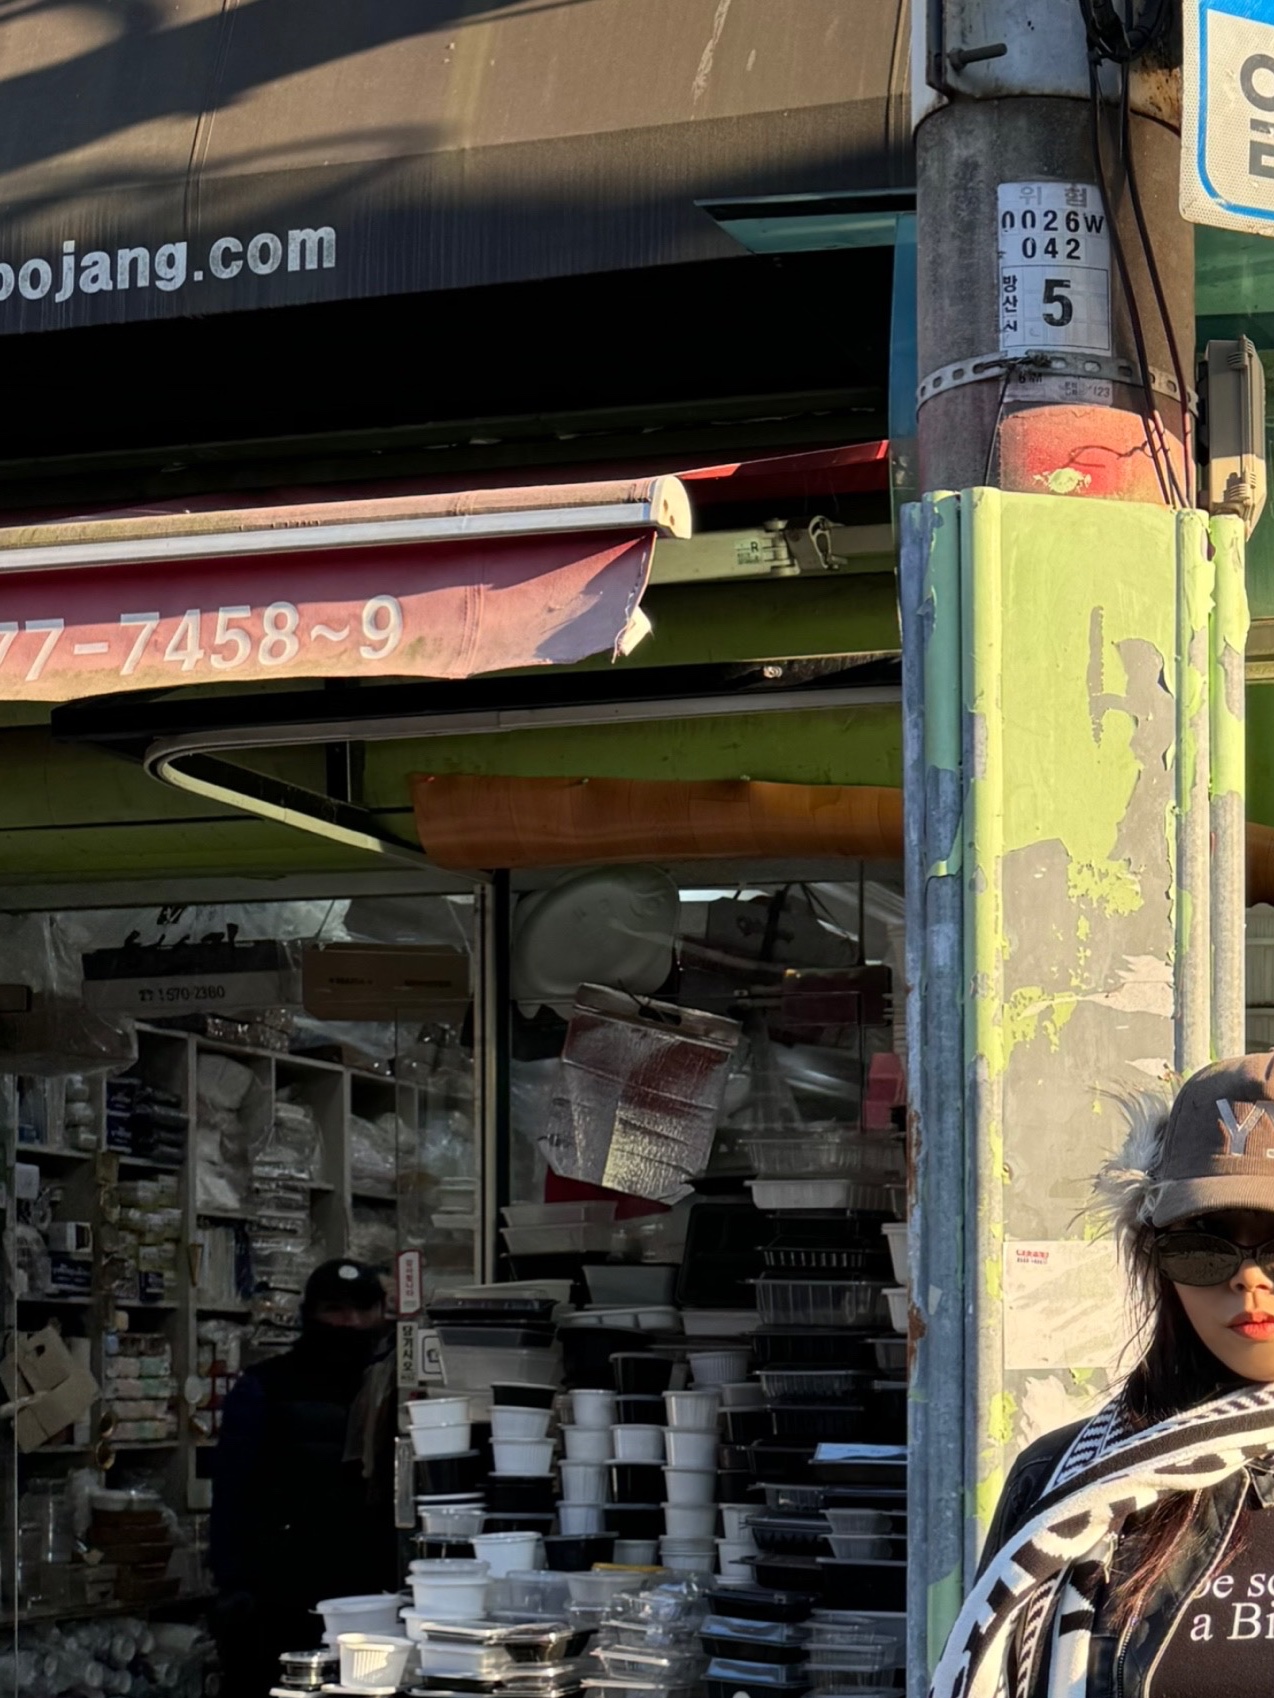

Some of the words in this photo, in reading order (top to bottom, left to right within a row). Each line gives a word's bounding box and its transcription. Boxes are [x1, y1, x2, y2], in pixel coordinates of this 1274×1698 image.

[1001, 209, 1105, 234] 0026W
[1022, 237, 1082, 260] 042
[1042, 278, 1074, 327] 5
[1190, 1613, 1213, 1642] a
